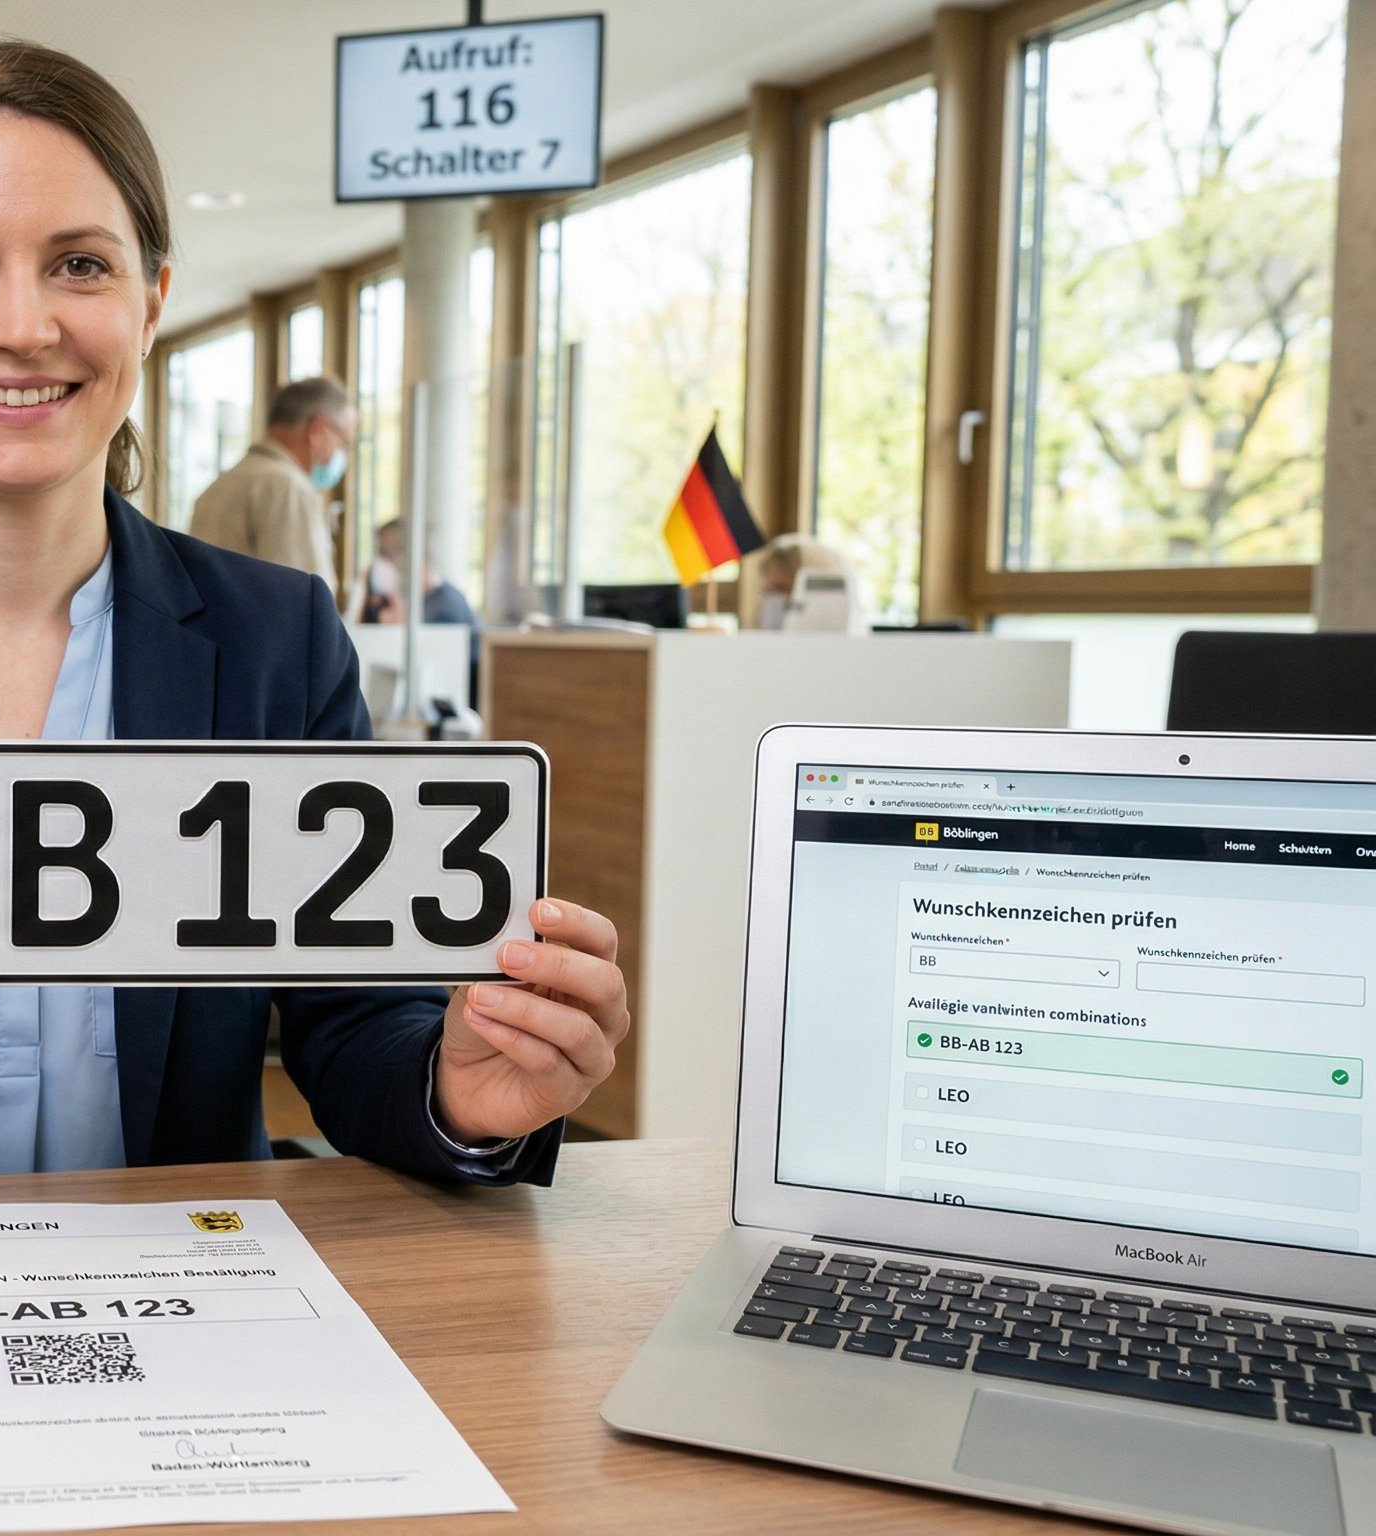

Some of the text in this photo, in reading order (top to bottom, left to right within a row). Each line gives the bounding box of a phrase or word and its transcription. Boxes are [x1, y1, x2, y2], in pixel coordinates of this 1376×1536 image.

[401, 35, 532, 73] Aufruf:
[419, 83, 515, 130] 116
[369, 139, 560, 181] Schalter 7
[1224, 841, 1256, 851] Home
[177, 781, 511, 947] 123
[913, 898, 1177, 929] Wunschkennzeichen prüfen
[919, 955, 937, 966] BB
[1137, 946, 1275, 964] Wunschkennzeichen prüfen
[1049, 1009, 1147, 1027] combinations
[940, 1035, 1023, 1055] BB-AB 123
[938, 1088, 970, 1103] LEO
[935, 1140, 967, 1155] LEO
[1115, 1244, 1207, 1267] MacBook Air
[106, 1298, 196, 1319] 123
